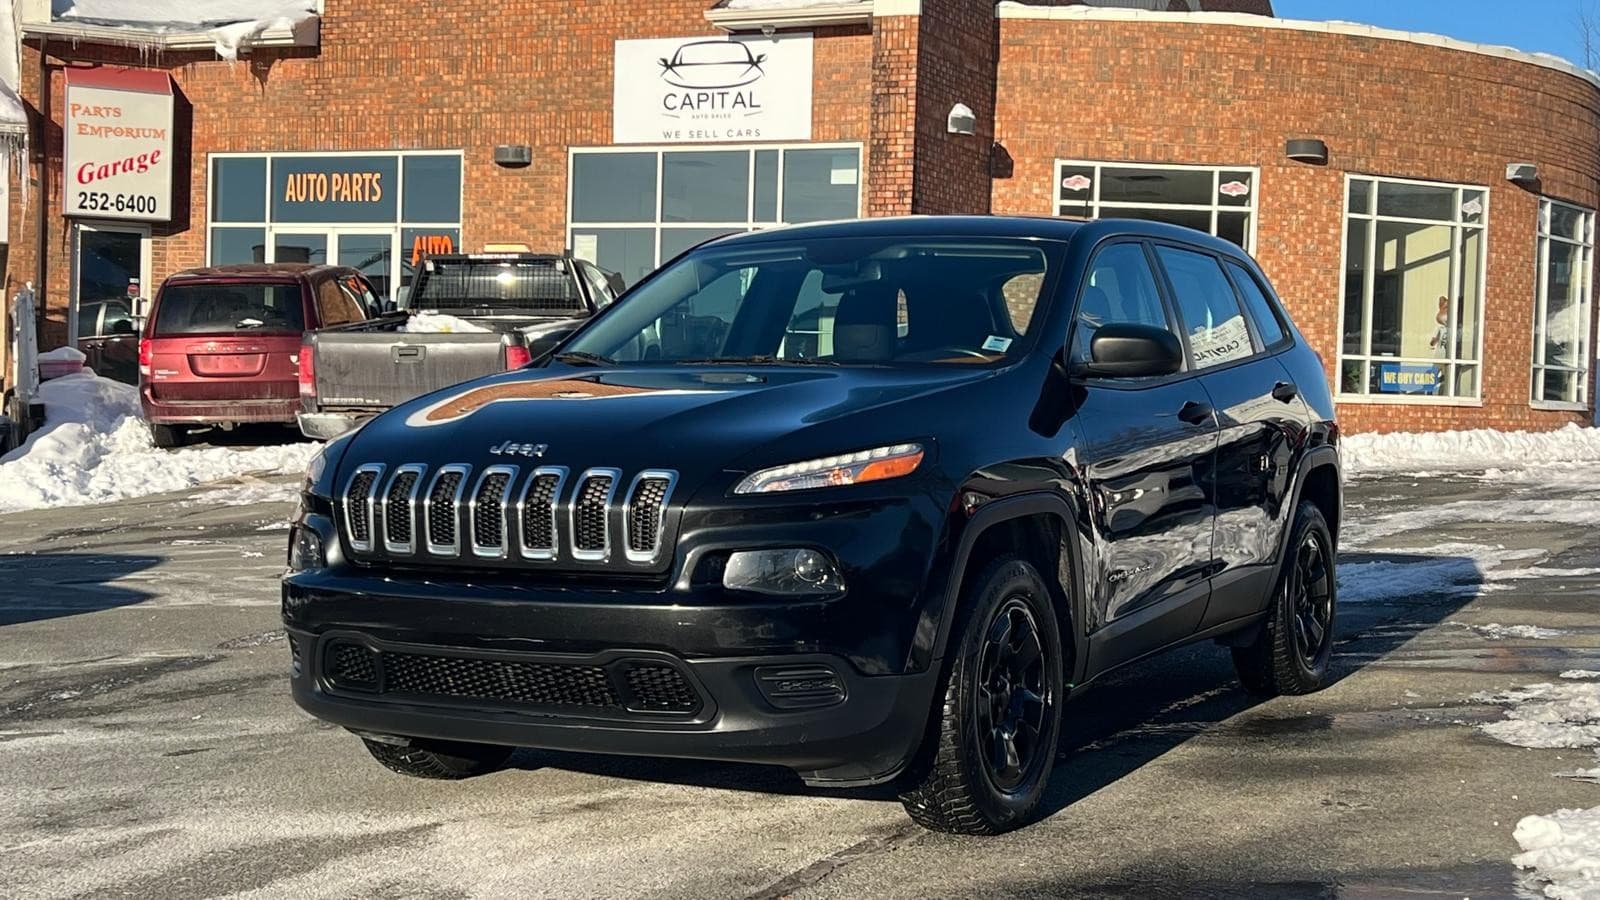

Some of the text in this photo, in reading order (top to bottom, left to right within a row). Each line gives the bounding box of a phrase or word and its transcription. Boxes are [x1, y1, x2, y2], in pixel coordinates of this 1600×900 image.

[663, 91, 761, 111] CAPITAL
[71, 103, 122, 118] PARTS
[77, 123, 166, 141] EMPORIUM
[662, 129, 761, 139] WE SELL CARS
[77, 149, 161, 185] Garage
[285, 172, 383, 202] AUTO PARTS
[78, 191, 157, 214] 252-6400
[1383, 371, 1436, 385] WE BUY CARS
[489, 440, 549, 457] Jeep
